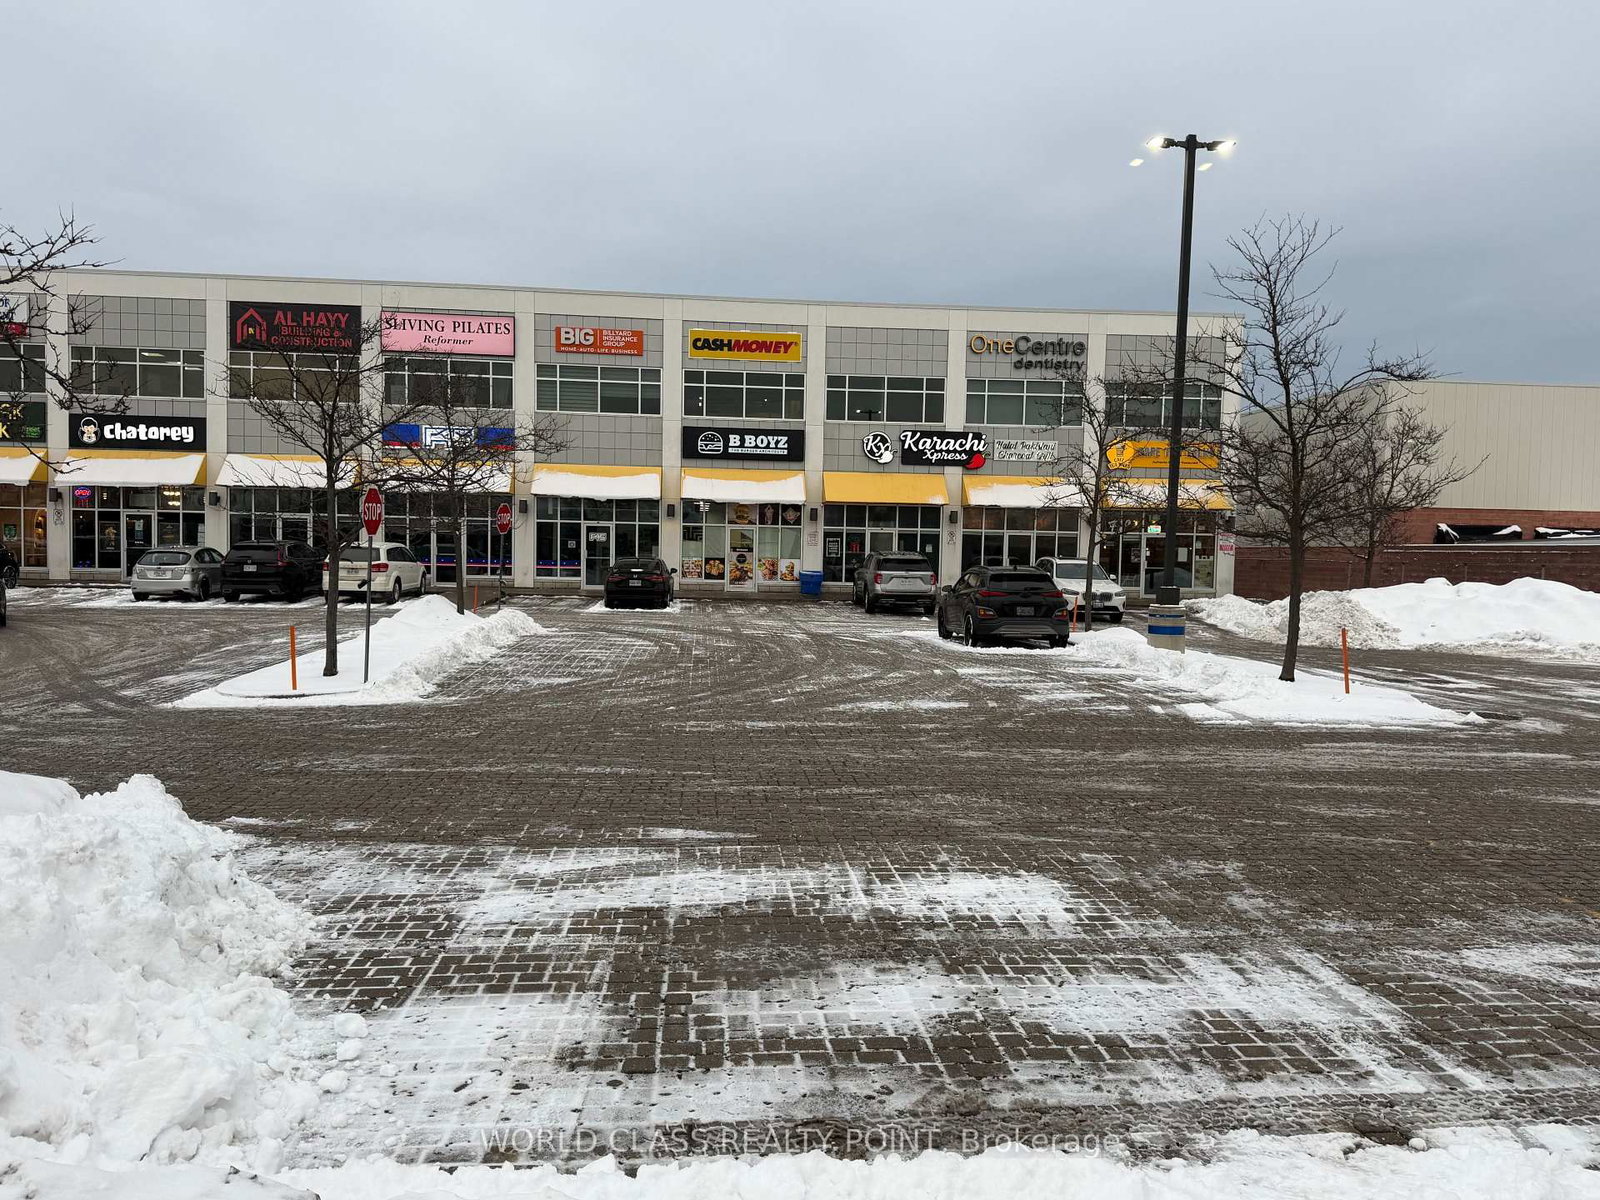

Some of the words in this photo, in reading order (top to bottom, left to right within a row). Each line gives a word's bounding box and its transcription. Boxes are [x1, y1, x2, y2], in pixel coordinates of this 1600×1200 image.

[274, 310, 297, 326] AL
[302, 311, 350, 328] HAYY
[281, 326, 331, 337] BUILING
[452, 320, 511, 335] PILATES
[423, 334, 474, 346] Reformer
[560, 327, 595, 346] BIG
[970, 335, 1086, 356] OneCentre
[1014, 358, 1085, 372] dentistry
[729, 434, 740, 446] B
[744, 435, 788, 448] BOYZ
[900, 431, 988, 452] Karachi
[996, 440, 1018, 450] Halal
[1020, 441, 1056, 450] Pakistani
[923, 449, 968, 463] Xpress
[998, 451, 1034, 460] Charcoal
[364, 503, 381, 520] STOP
[498, 513, 511, 524] STOP
